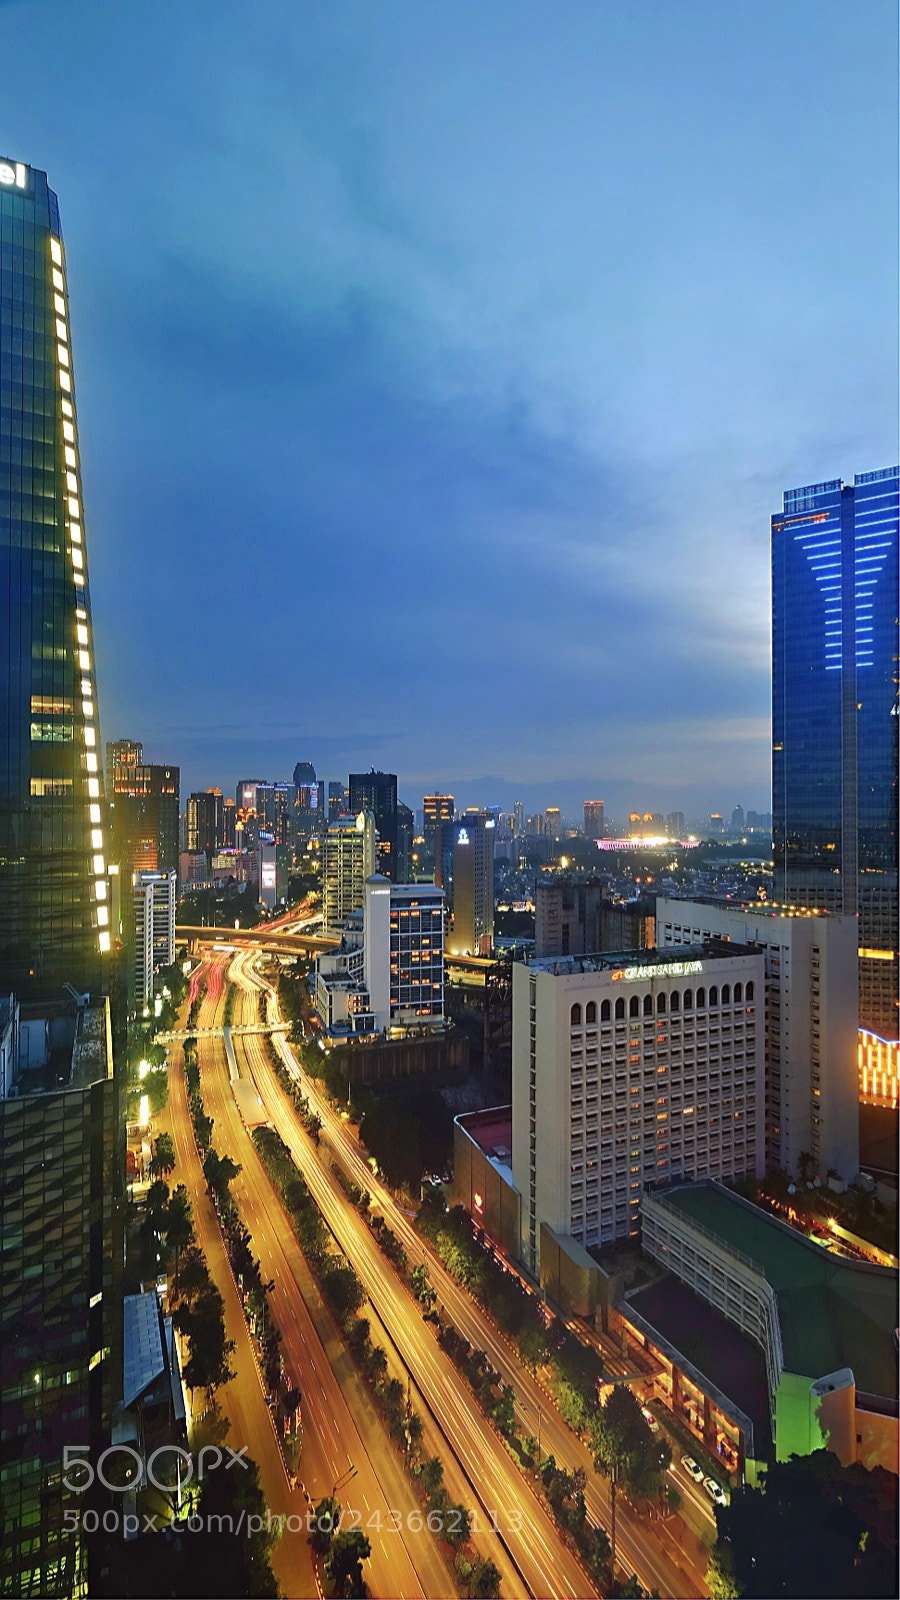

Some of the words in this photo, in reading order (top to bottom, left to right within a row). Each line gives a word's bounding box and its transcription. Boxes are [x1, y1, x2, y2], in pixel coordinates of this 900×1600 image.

[624, 965, 657, 979] GRAND
[658, 962, 683, 976] SAHID
[684, 960, 703, 976] JAYA
